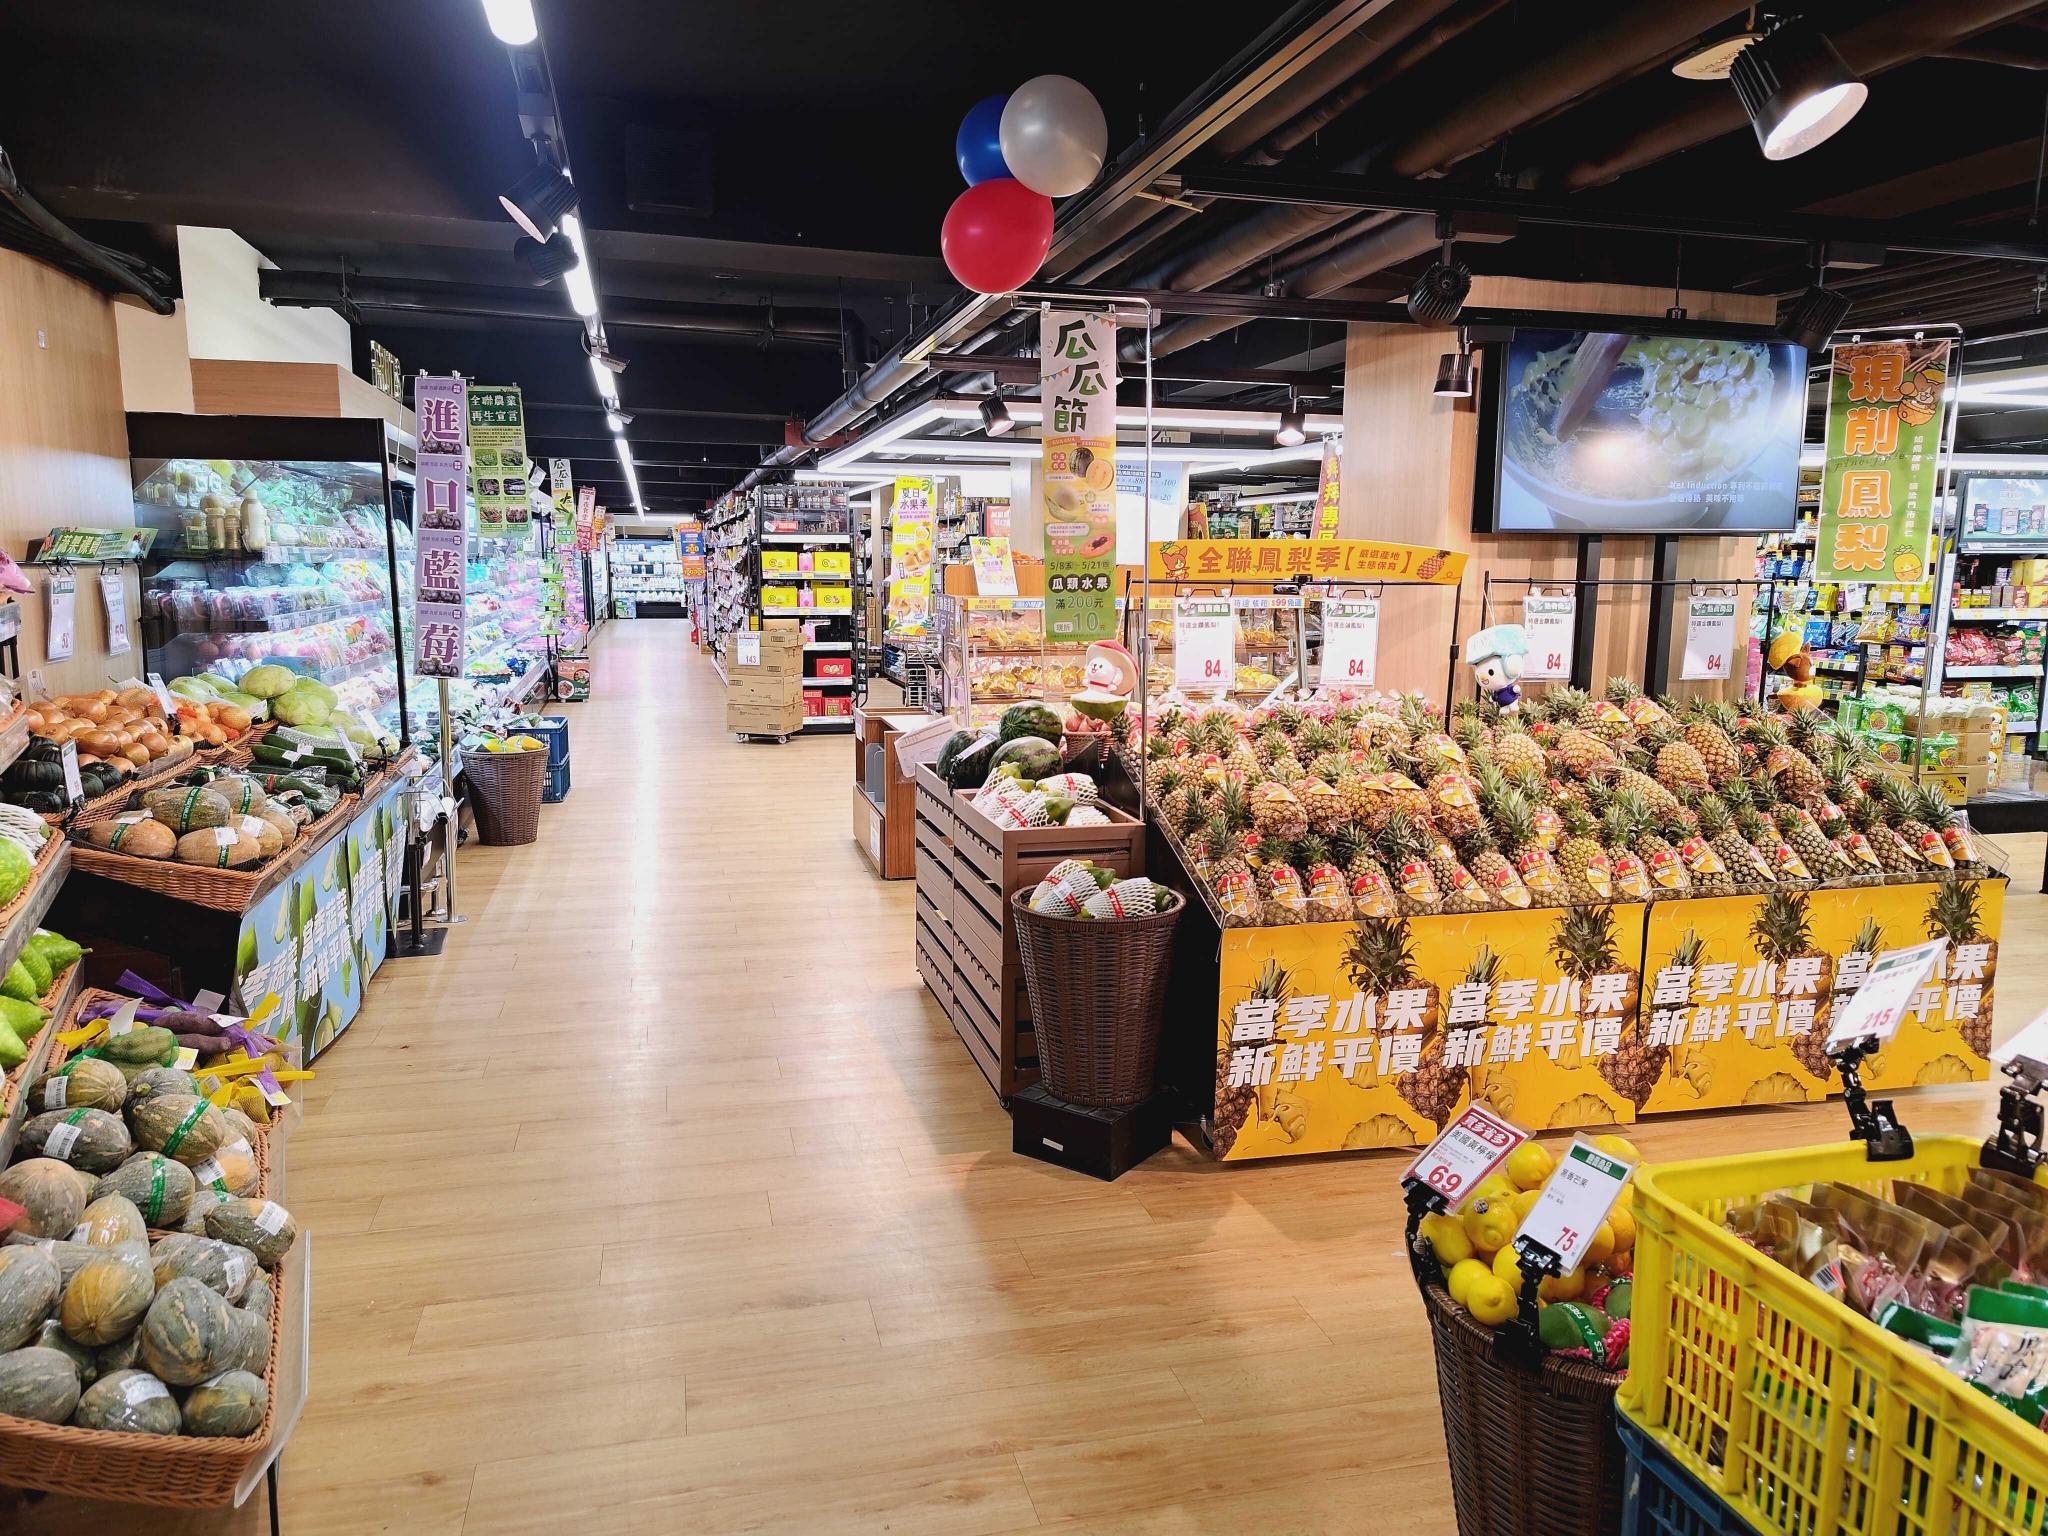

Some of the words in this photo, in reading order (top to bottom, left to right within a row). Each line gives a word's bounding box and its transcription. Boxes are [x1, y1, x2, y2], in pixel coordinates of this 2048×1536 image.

[1053, 319, 1108, 434] 瓜瓜節
[470, 395, 518, 406] 全聯農業
[472, 410, 518, 422] 再生宣言
[1833, 354, 1905, 571] 現削鳳梨
[900, 498, 928, 510] 水果季
[421, 399, 460, 663] 進口藍莓
[1198, 546, 1341, 574] 全聯鳳梨季
[1356, 560, 1398, 571] 生態保育
[1359, 549, 1400, 561] 嚴選產地
[1052, 576, 1108, 590] 瓜類水果
[1055, 595, 1104, 610] 滿200元
[746, 655, 757, 664] 143
[1204, 659, 1221, 678] 84
[1348, 659, 1364, 677] 84
[1546, 653, 1561, 670] 84
[1707, 654, 1721, 670] 84
[1652, 957, 1823, 1006] 當季水果
[1445, 973, 1630, 1026] 當季水果
[1231, 987, 1429, 1042] 當季水果
[1646, 999, 1817, 1047] 新鮮平價
[1860, 1007, 1894, 1031] 215
[1442, 1016, 1623, 1069] 新鮮平價
[1226, 1032, 1425, 1088] 新鮮平價
[1463, 1115, 1509, 1144] 買多省多
[1450, 1129, 1499, 1161] 美國黃檸檬
[1428, 1164, 1463, 1193] 69
[1555, 1225, 1580, 1252] 75
